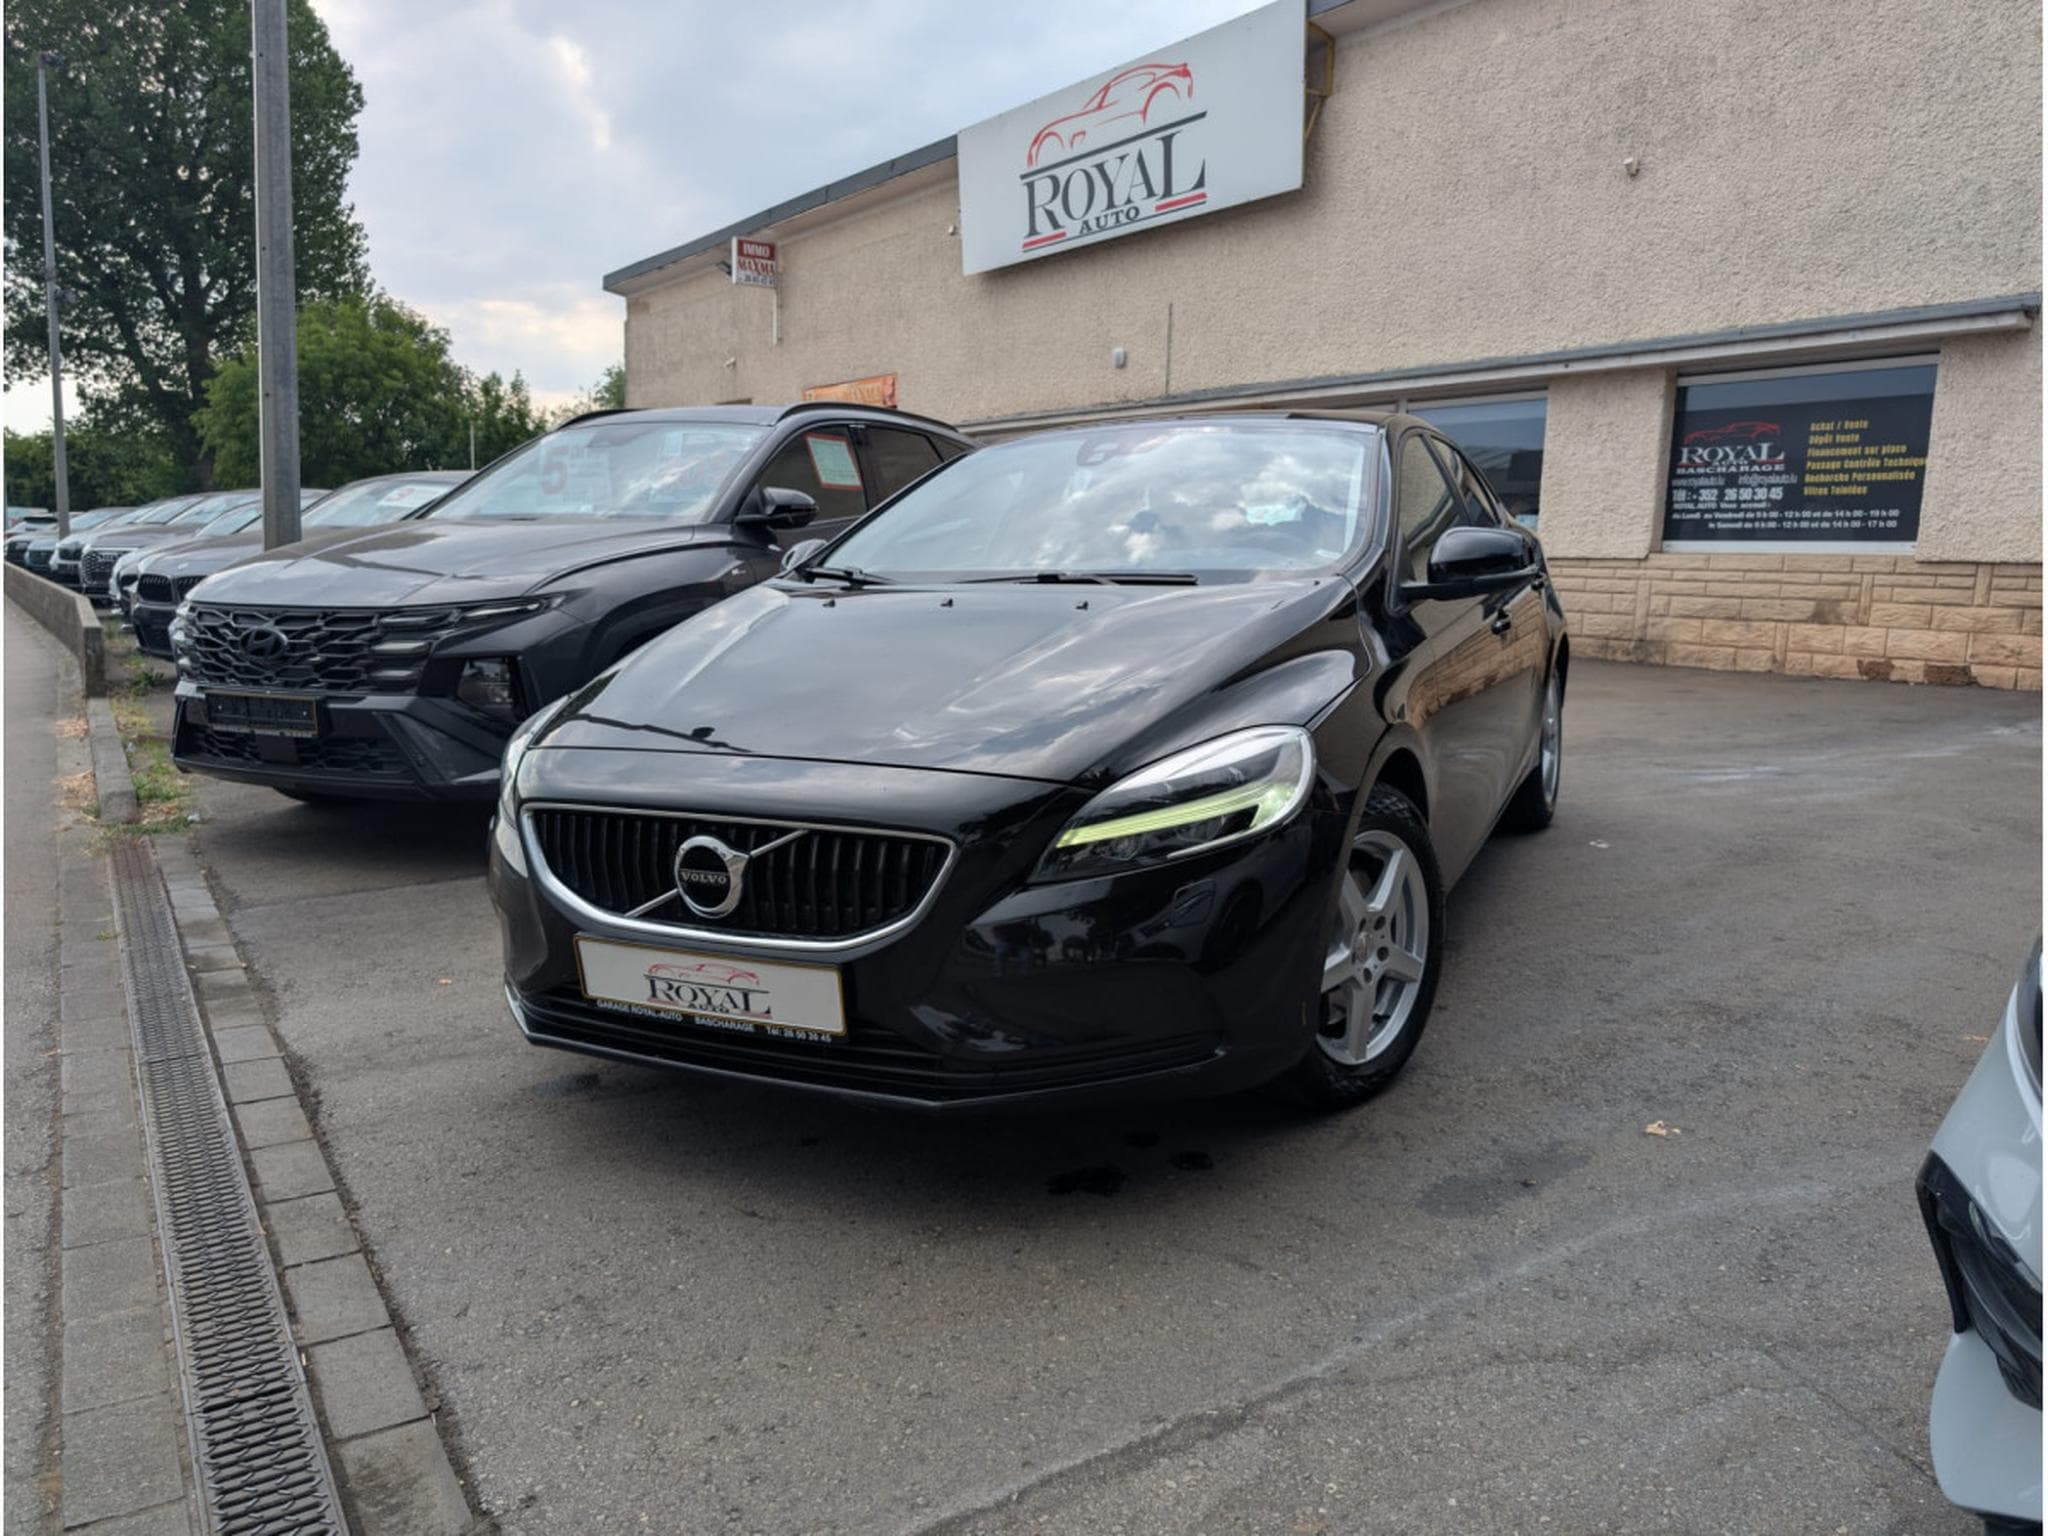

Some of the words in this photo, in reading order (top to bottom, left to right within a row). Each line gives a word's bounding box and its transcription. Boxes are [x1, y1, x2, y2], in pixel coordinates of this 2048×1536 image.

[1022, 130, 1207, 238] ROYAL
[1078, 205, 1141, 236] AUTO
[743, 242, 770, 258] IMMO
[1679, 442, 1786, 465] ROYAL
[1864, 446, 1879, 455] sur
[1676, 464, 1785, 475] BASCHARAGE
[1698, 488, 1718, 501] 352
[1723, 488, 1738, 501] 26
[1739, 487, 1752, 500] 50
[1753, 487, 1767, 500] 30
[1768, 486, 1783, 500] 45
[1868, 520, 1878, 528] 17
[680, 872, 727, 885] VOLVO
[648, 979, 771, 1015] ROYAL
[687, 1002, 730, 1014] AUTO
